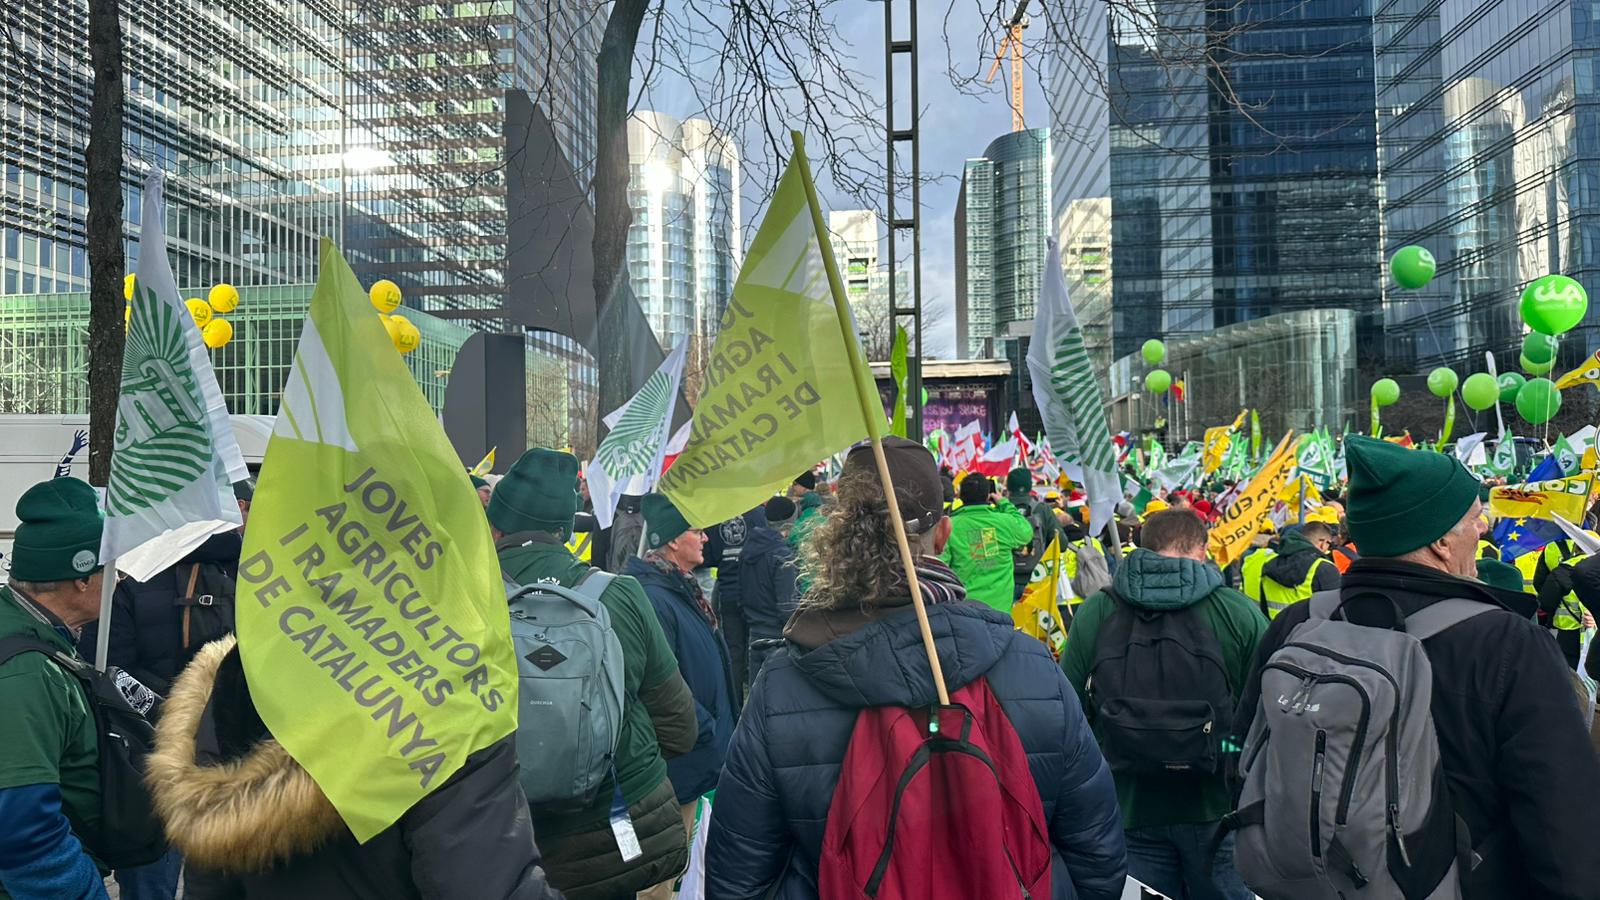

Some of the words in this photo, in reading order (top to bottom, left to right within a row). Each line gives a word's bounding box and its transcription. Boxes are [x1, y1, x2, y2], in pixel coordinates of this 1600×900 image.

[279, 522, 309, 547] I
[343, 466, 444, 571] JOVES
[238, 550, 292, 608] DE
[278, 606, 448, 789] CATALUNYA
[293, 544, 454, 708] RAMADERS
[315, 501, 505, 713] AGRICULTORS
